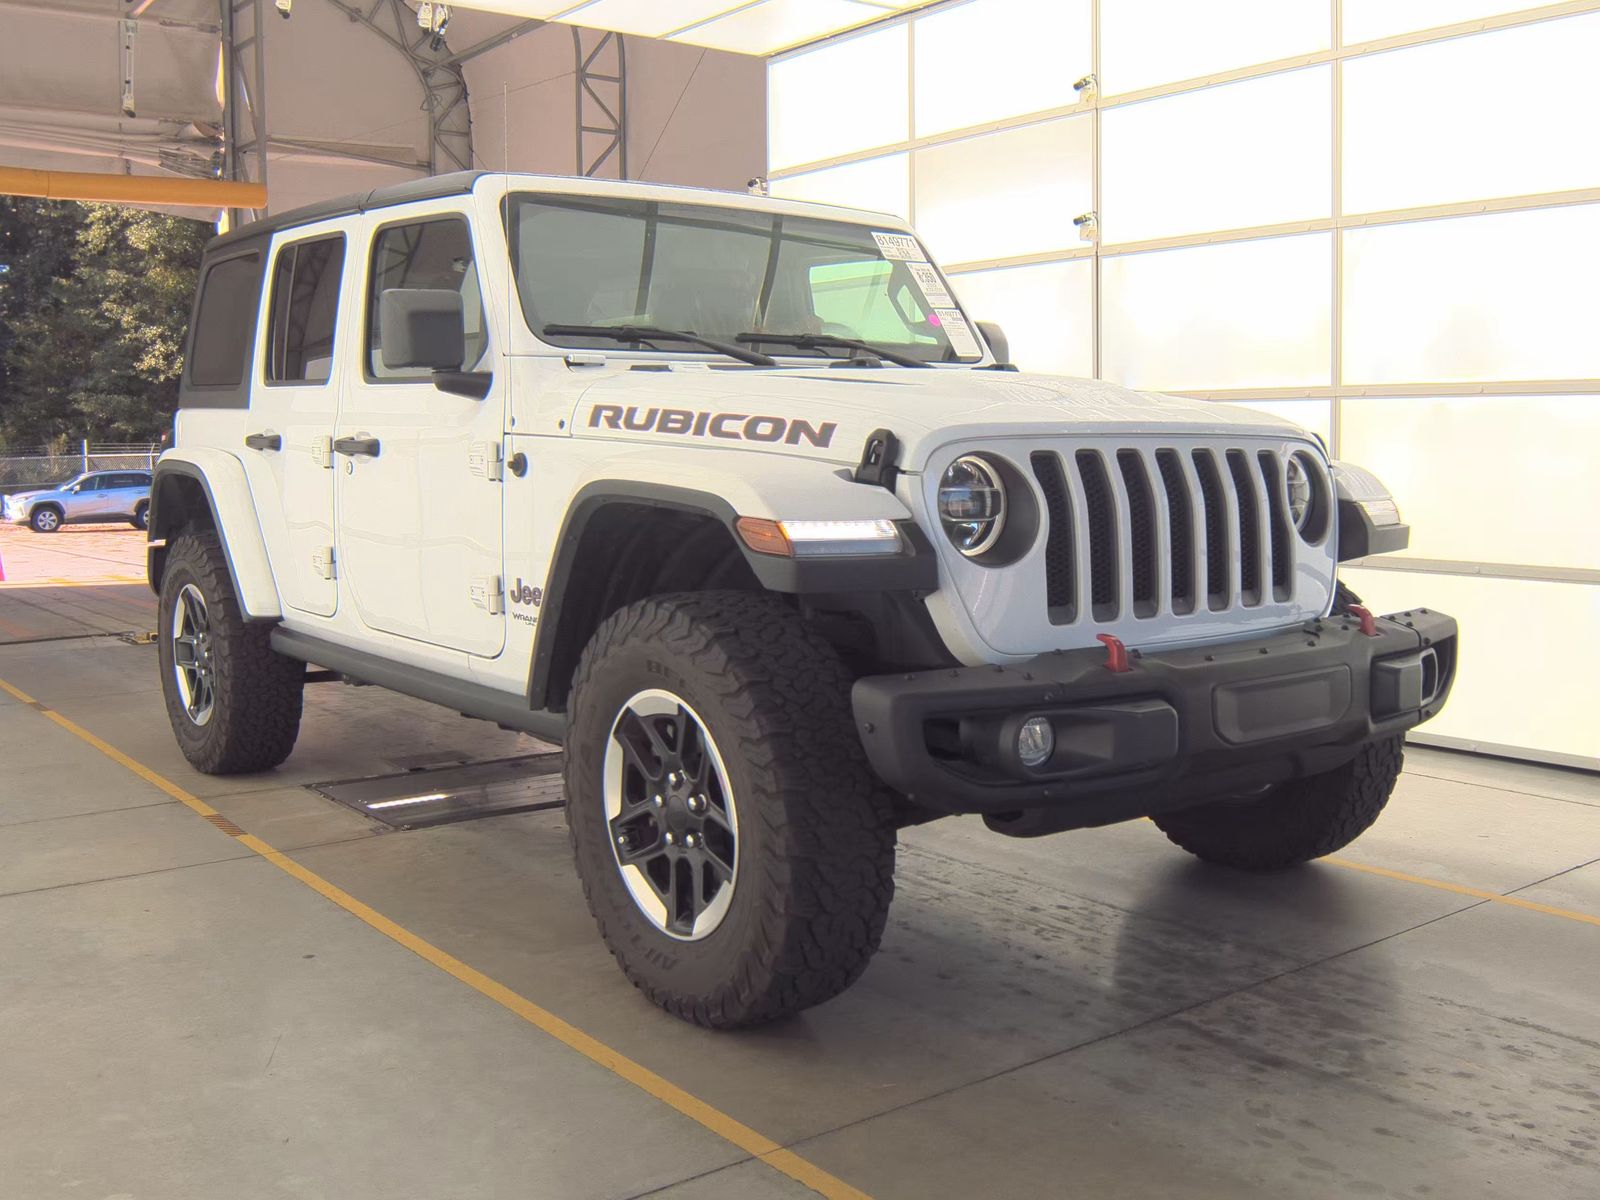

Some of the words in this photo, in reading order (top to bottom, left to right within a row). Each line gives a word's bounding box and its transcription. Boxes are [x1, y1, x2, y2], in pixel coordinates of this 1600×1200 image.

[875, 234, 917, 249] 8149771
[588, 404, 838, 448] RUBICON
[510, 578, 544, 607] Jee
